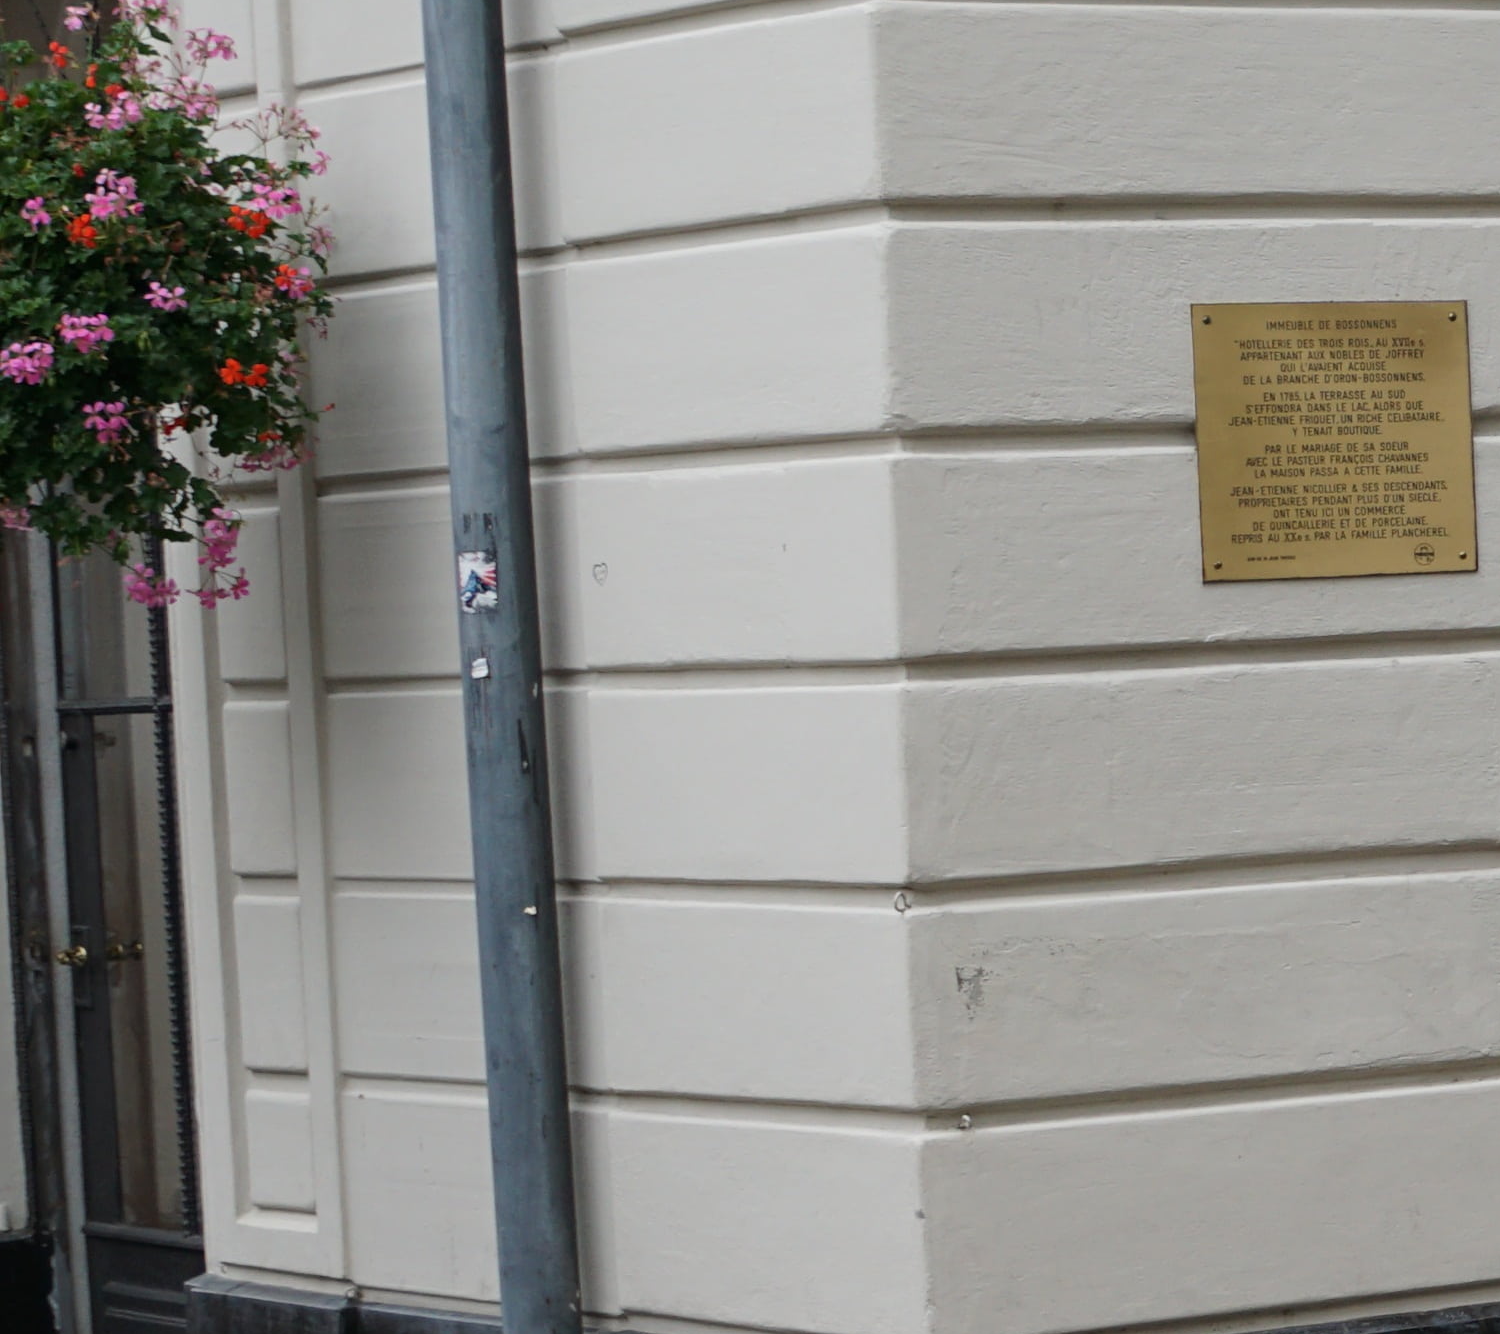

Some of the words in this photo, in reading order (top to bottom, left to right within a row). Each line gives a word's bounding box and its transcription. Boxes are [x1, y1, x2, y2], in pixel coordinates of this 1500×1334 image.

[1266, 320, 1314, 331] IMMEUBLE
[1318, 319, 1332, 330] DE
[1336, 318, 1398, 330] BOSSONNENS
[1297, 338, 1315, 349] DES
[1318, 338, 1344, 348] TROIS
[1376, 337, 1388, 347] AU
[1240, 351, 1303, 362] APPARTENANT
[1308, 350, 1325, 360] AUX
[1330, 349, 1365, 360] NOBLES
[1369, 349, 1381, 359] DE
[1385, 348, 1425, 359] JOFFREY
[1280, 363, 1296, 373] QUI
[1301, 362, 1343, 373] L'AVAIENT
[1348, 361, 1387, 371] ACQUISE
[1243, 375, 1256, 385] DE
[1260, 375, 1272, 385] LA
[1276, 374, 1320, 385] BRANCHE
[1263, 392, 1276, 402] EN
[1304, 391, 1316, 401] LA
[1320, 390, 1366, 401] TERRASSE
[1371, 390, 1383, 400] AU
[1388, 389, 1406, 399] SUD
[1246, 403, 1302, 414] S'EFFONDRA
[1307, 402, 1332, 413] DANS
[1336, 402, 1346, 412] LE
[1373, 401, 1402, 411] ALORS
[1405, 400, 1424, 410] QUE
[1228, 415, 1296, 427] JEAN-ETIENNE
[1341, 414, 1353, 424] UN
[1357, 413, 1384, 423] RICHE
[1292, 428, 1298, 437] Y
[1302, 426, 1333, 437] TENAIT
[1264, 444, 1282, 454] PAR
[1286, 443, 1297, 454] LE
[1301, 442, 1343, 453] MARIAGE
[1346, 442, 1359, 453] DE
[1363, 442, 1375, 452] SA
[1380, 441, 1409, 451] SOEUR
[1246, 457, 1269, 467] AVEC
[1272, 456, 1283, 466] LE
[1287, 455, 1326, 466] PASTEUR
[1330, 454, 1374, 465] FRANÇOIS
[1378, 452, 1429, 463] CHAVANNES
[1254, 469, 1267, 479] LA
[1270, 468, 1305, 478] MAISON
[1310, 467, 1339, 477] PASSA
[1344, 466, 1351, 476] A
[1354, 465, 1381, 476] CETTE
[1303, 483, 1347, 494] NICOLLIER
[1352, 483, 1358, 493] &
[1362, 483, 1379, 493] SES
[1238, 496, 1308, 508] PROPRIETAIRES
[1312, 495, 1353, 506] PENDANT
[1357, 494, 1379, 505] PLUS
[1383, 493, 1405, 504] D'UN
[1273, 509, 1291, 519] ONT
[1295, 508, 1317, 518] TENU
[1322, 507, 1334, 517] ICI
[1337, 507, 1350, 517] UN
[1354, 505, 1406, 516] COMMERCE
[1252, 521, 1266, 532] DE
[1269, 519, 1336, 531] QUINCAILLERIE
[1340, 518, 1351, 529] ET
[1355, 518, 1367, 528] DE
[1231, 534, 1263, 544] REPRIS
[1267, 533, 1280, 543] AU
[1314, 531, 1331, 541] PAR
[1335, 530, 1347, 541] LA
[1351, 529, 1387, 540] FAMILLE
